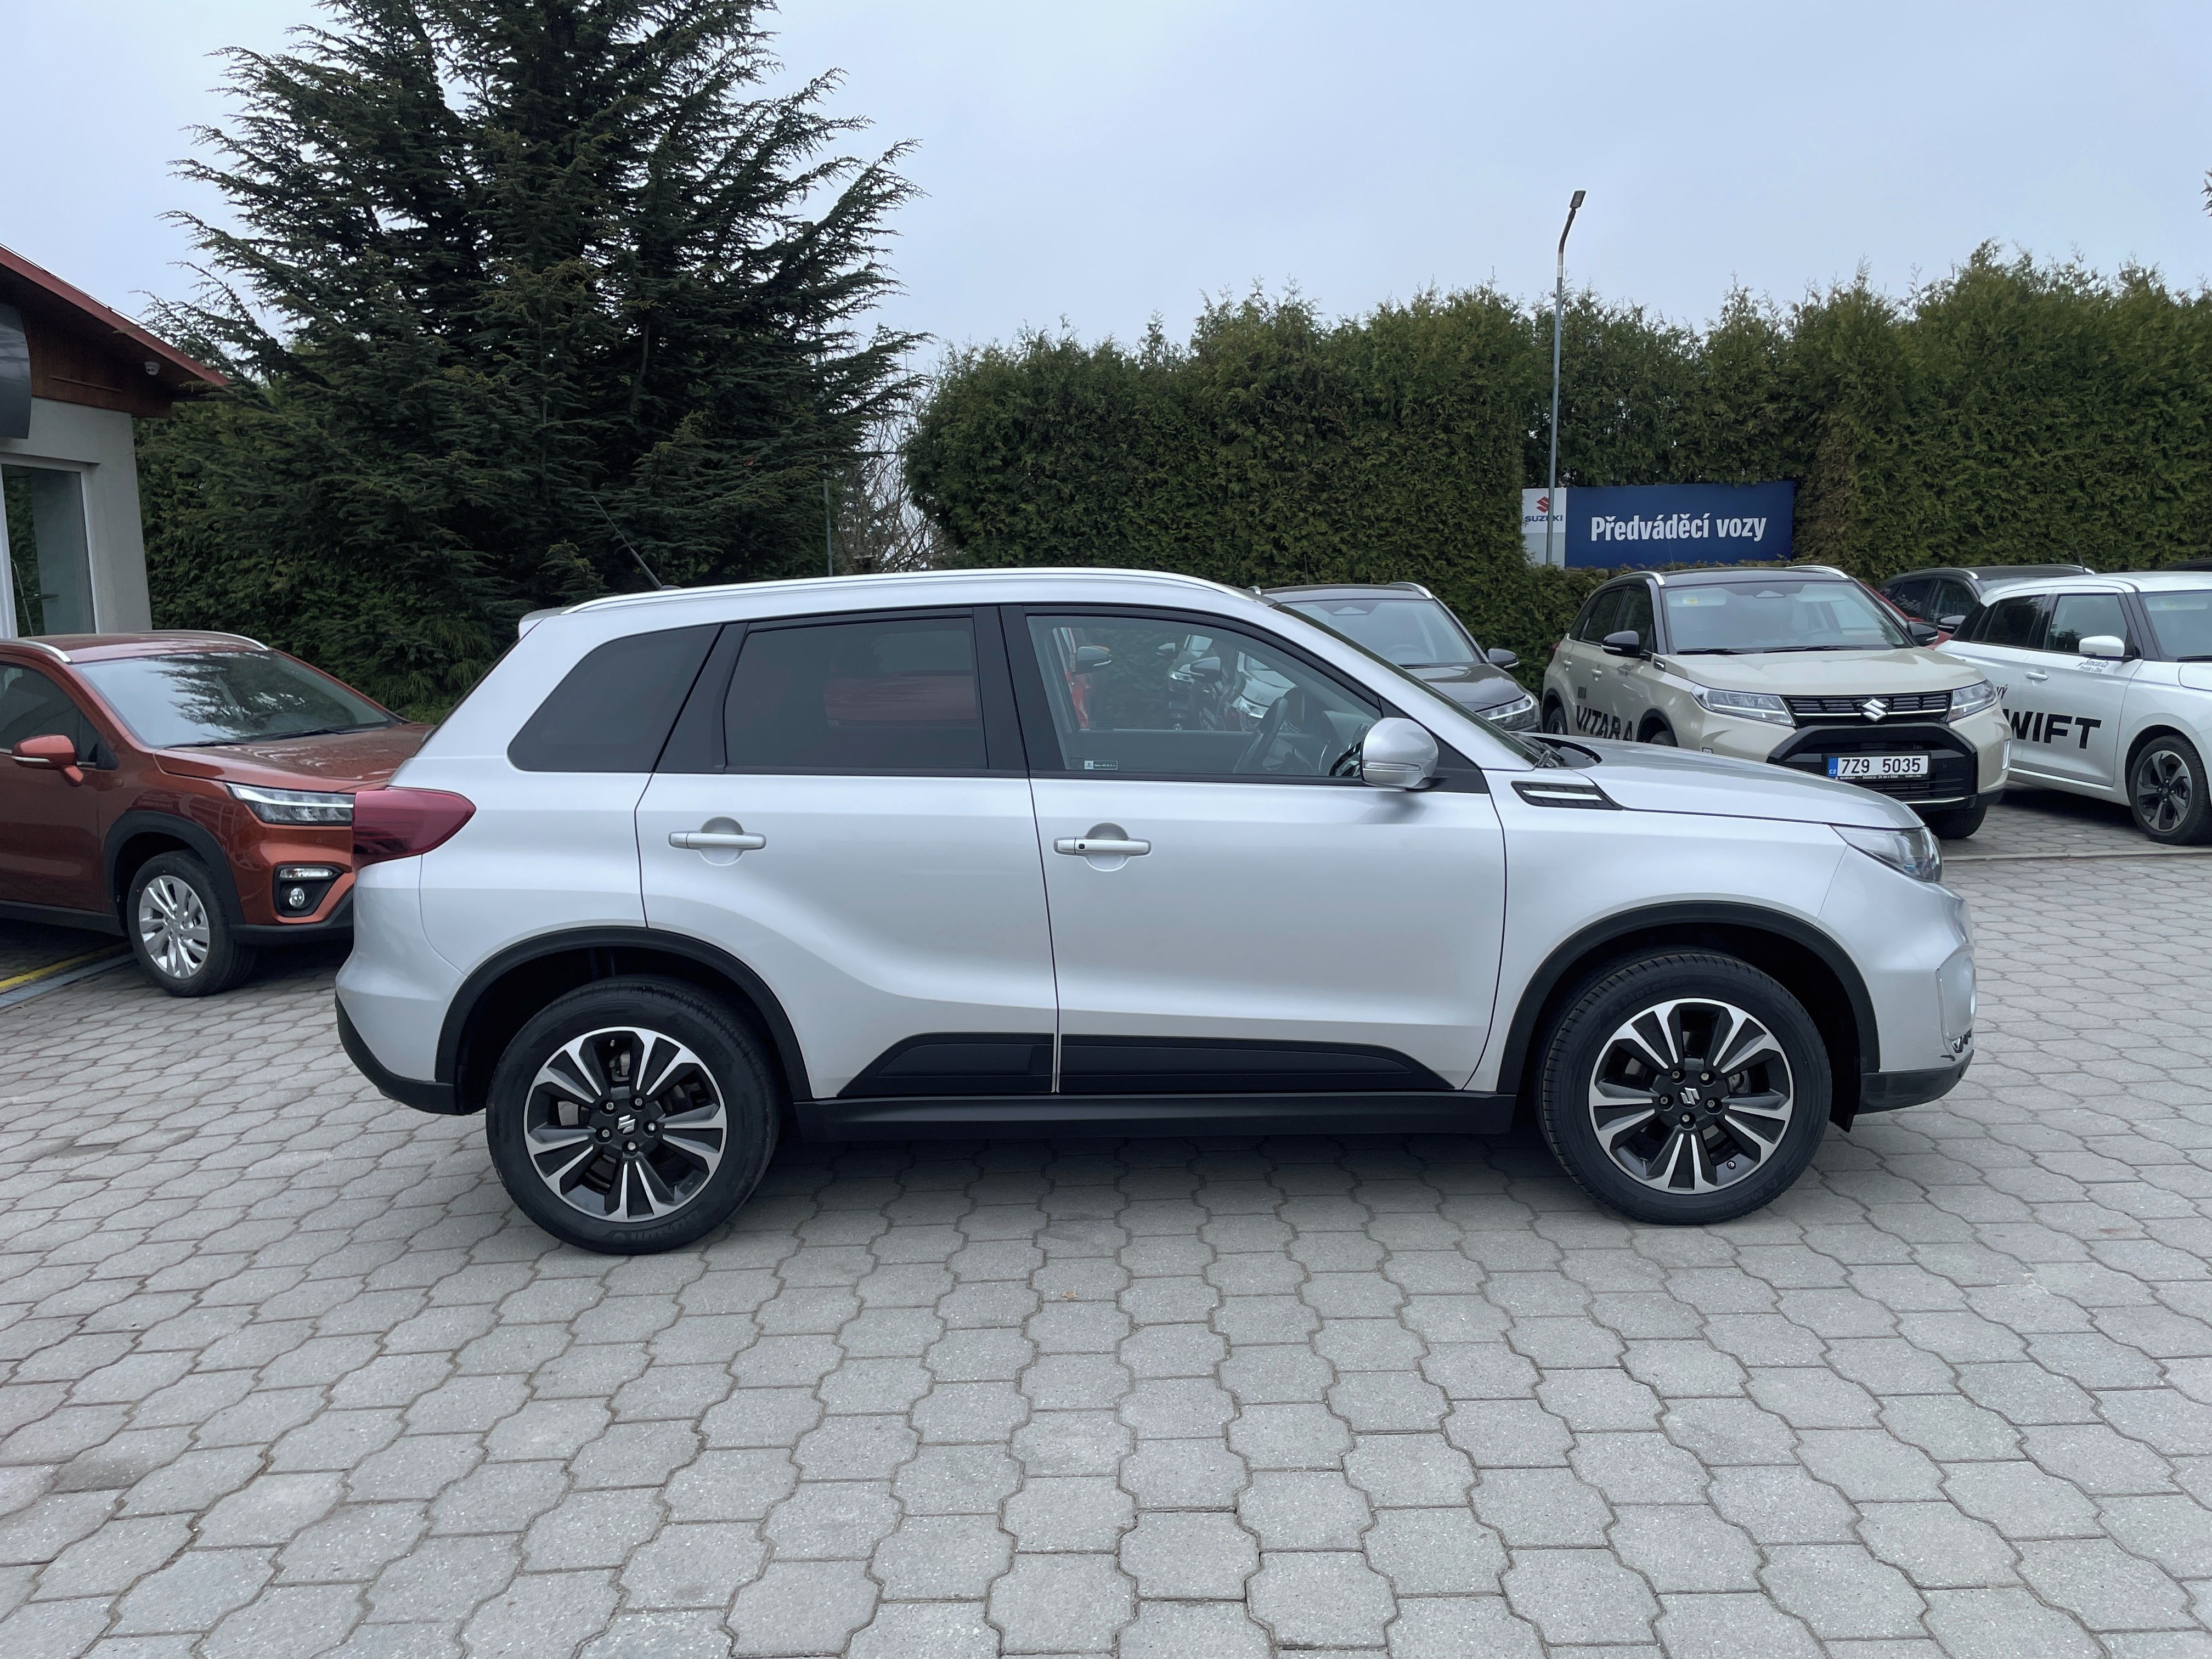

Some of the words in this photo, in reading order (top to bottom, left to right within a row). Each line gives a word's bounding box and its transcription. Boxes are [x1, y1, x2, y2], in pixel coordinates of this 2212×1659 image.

[1591, 513, 1711, 541] Předváděcí
[1716, 517, 1767, 541] vozy
[1996, 684, 2008, 700] VÝ
[1576, 704, 1633, 741] VITARA
[2002, 708, 2102, 749] WIFT
[1841, 759, 1870, 774] 7Z9
[1882, 758, 1921, 774] 5035
